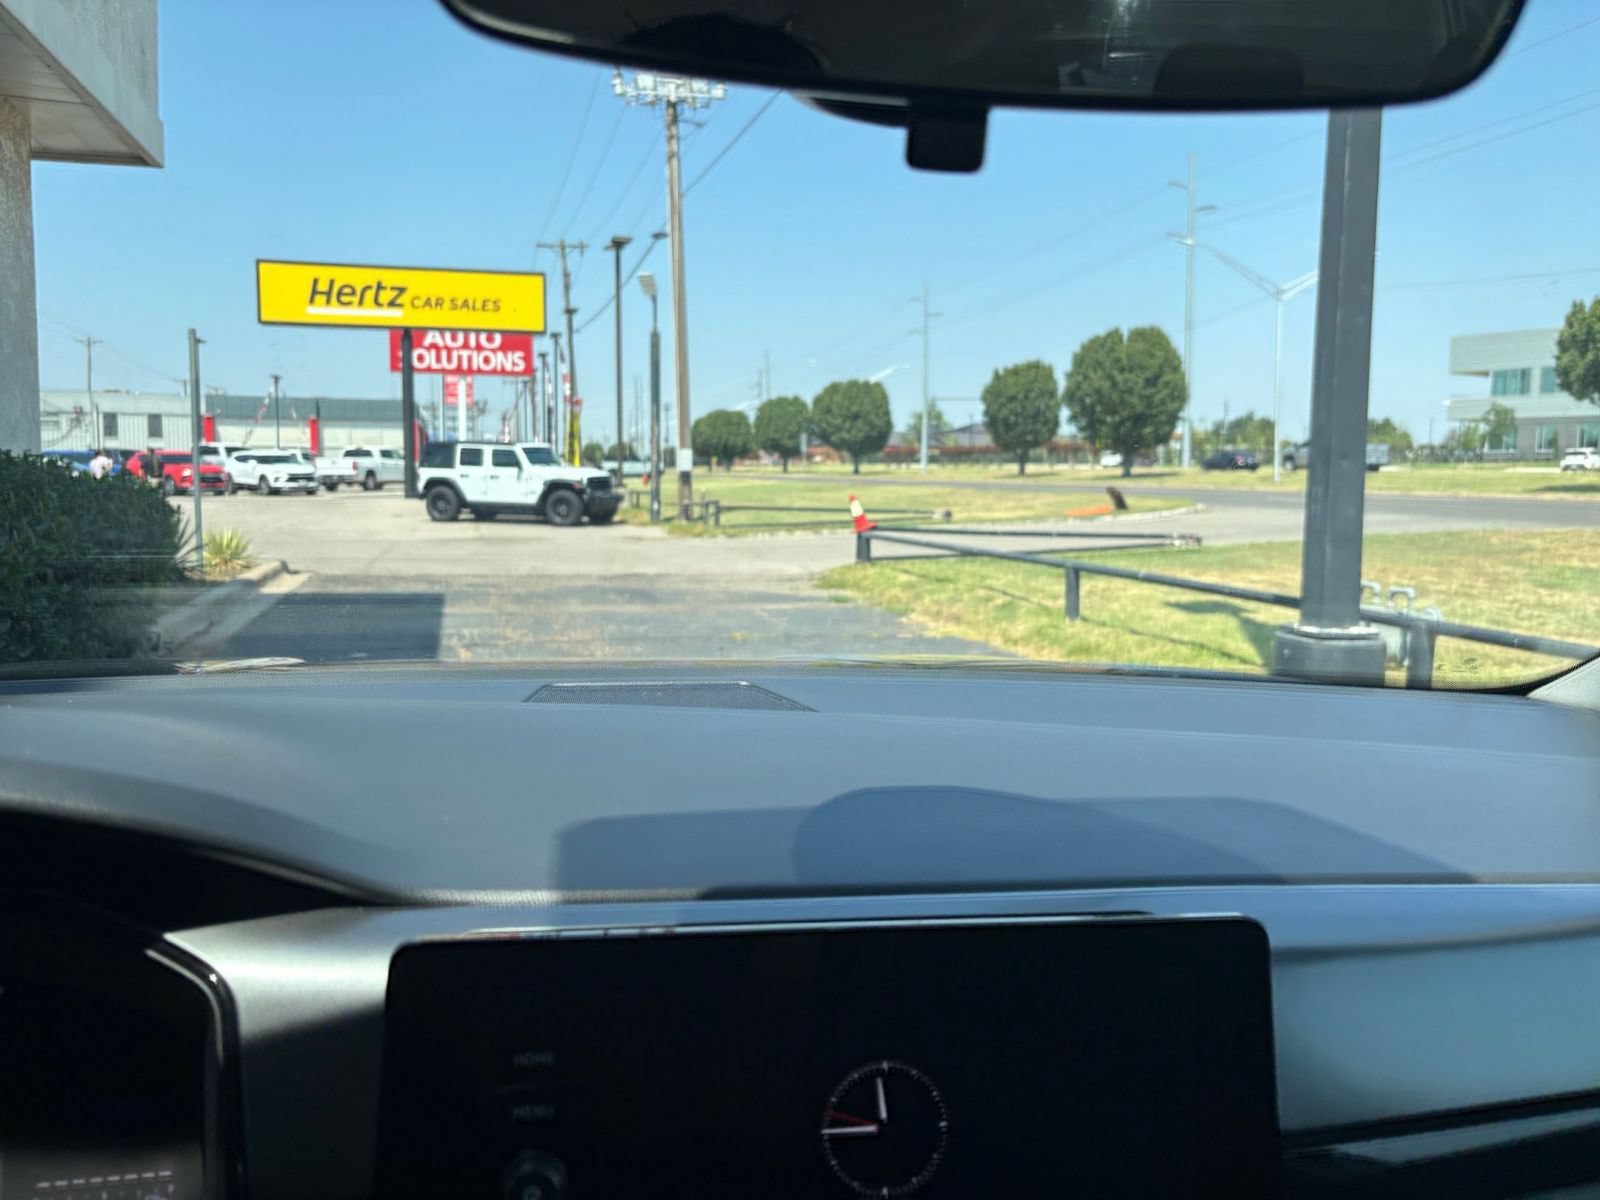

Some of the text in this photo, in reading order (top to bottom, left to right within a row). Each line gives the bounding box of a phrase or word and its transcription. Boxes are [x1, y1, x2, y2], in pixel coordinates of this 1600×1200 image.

[308, 277, 501, 312] Hertz CAR SALES
[422, 330, 502, 349] AUTO
[398, 349, 526, 372] OLUTIONS
[513, 1051, 556, 1067] HOME
[513, 1105, 555, 1120] MENU
